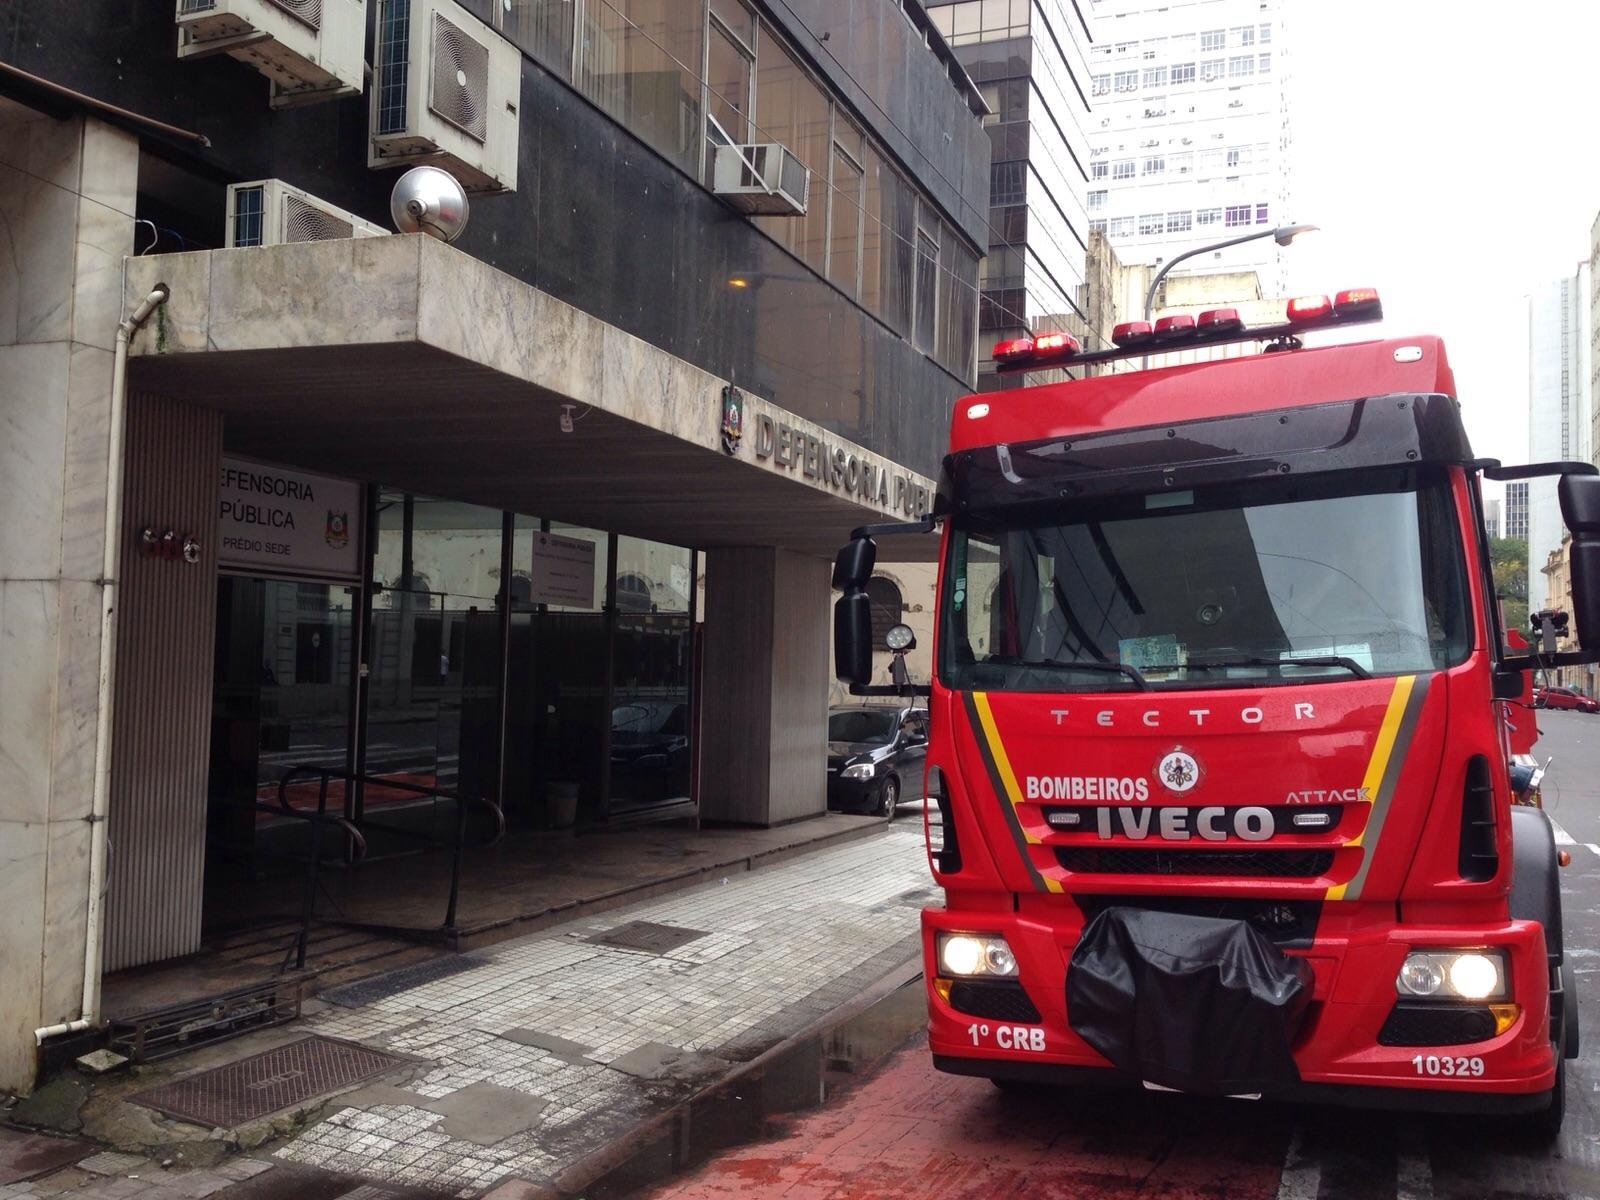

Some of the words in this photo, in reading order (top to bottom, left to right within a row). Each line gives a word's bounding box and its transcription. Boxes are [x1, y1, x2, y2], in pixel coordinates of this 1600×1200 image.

[755, 414, 889, 507] DEFENSORIA
[219, 499, 296, 530] PÚBLICA
[223, 537, 263, 552] PRÉDIO
[265, 542, 292, 556] SEDE
[1051, 702, 1315, 727] TECTOR
[1026, 776, 1149, 801] BOMBEIROS
[1285, 787, 1370, 804] ATTACK
[1096, 806, 1275, 841] IVECO
[996, 1026, 1046, 1052] CRB
[1412, 1055, 1485, 1076] 10329
